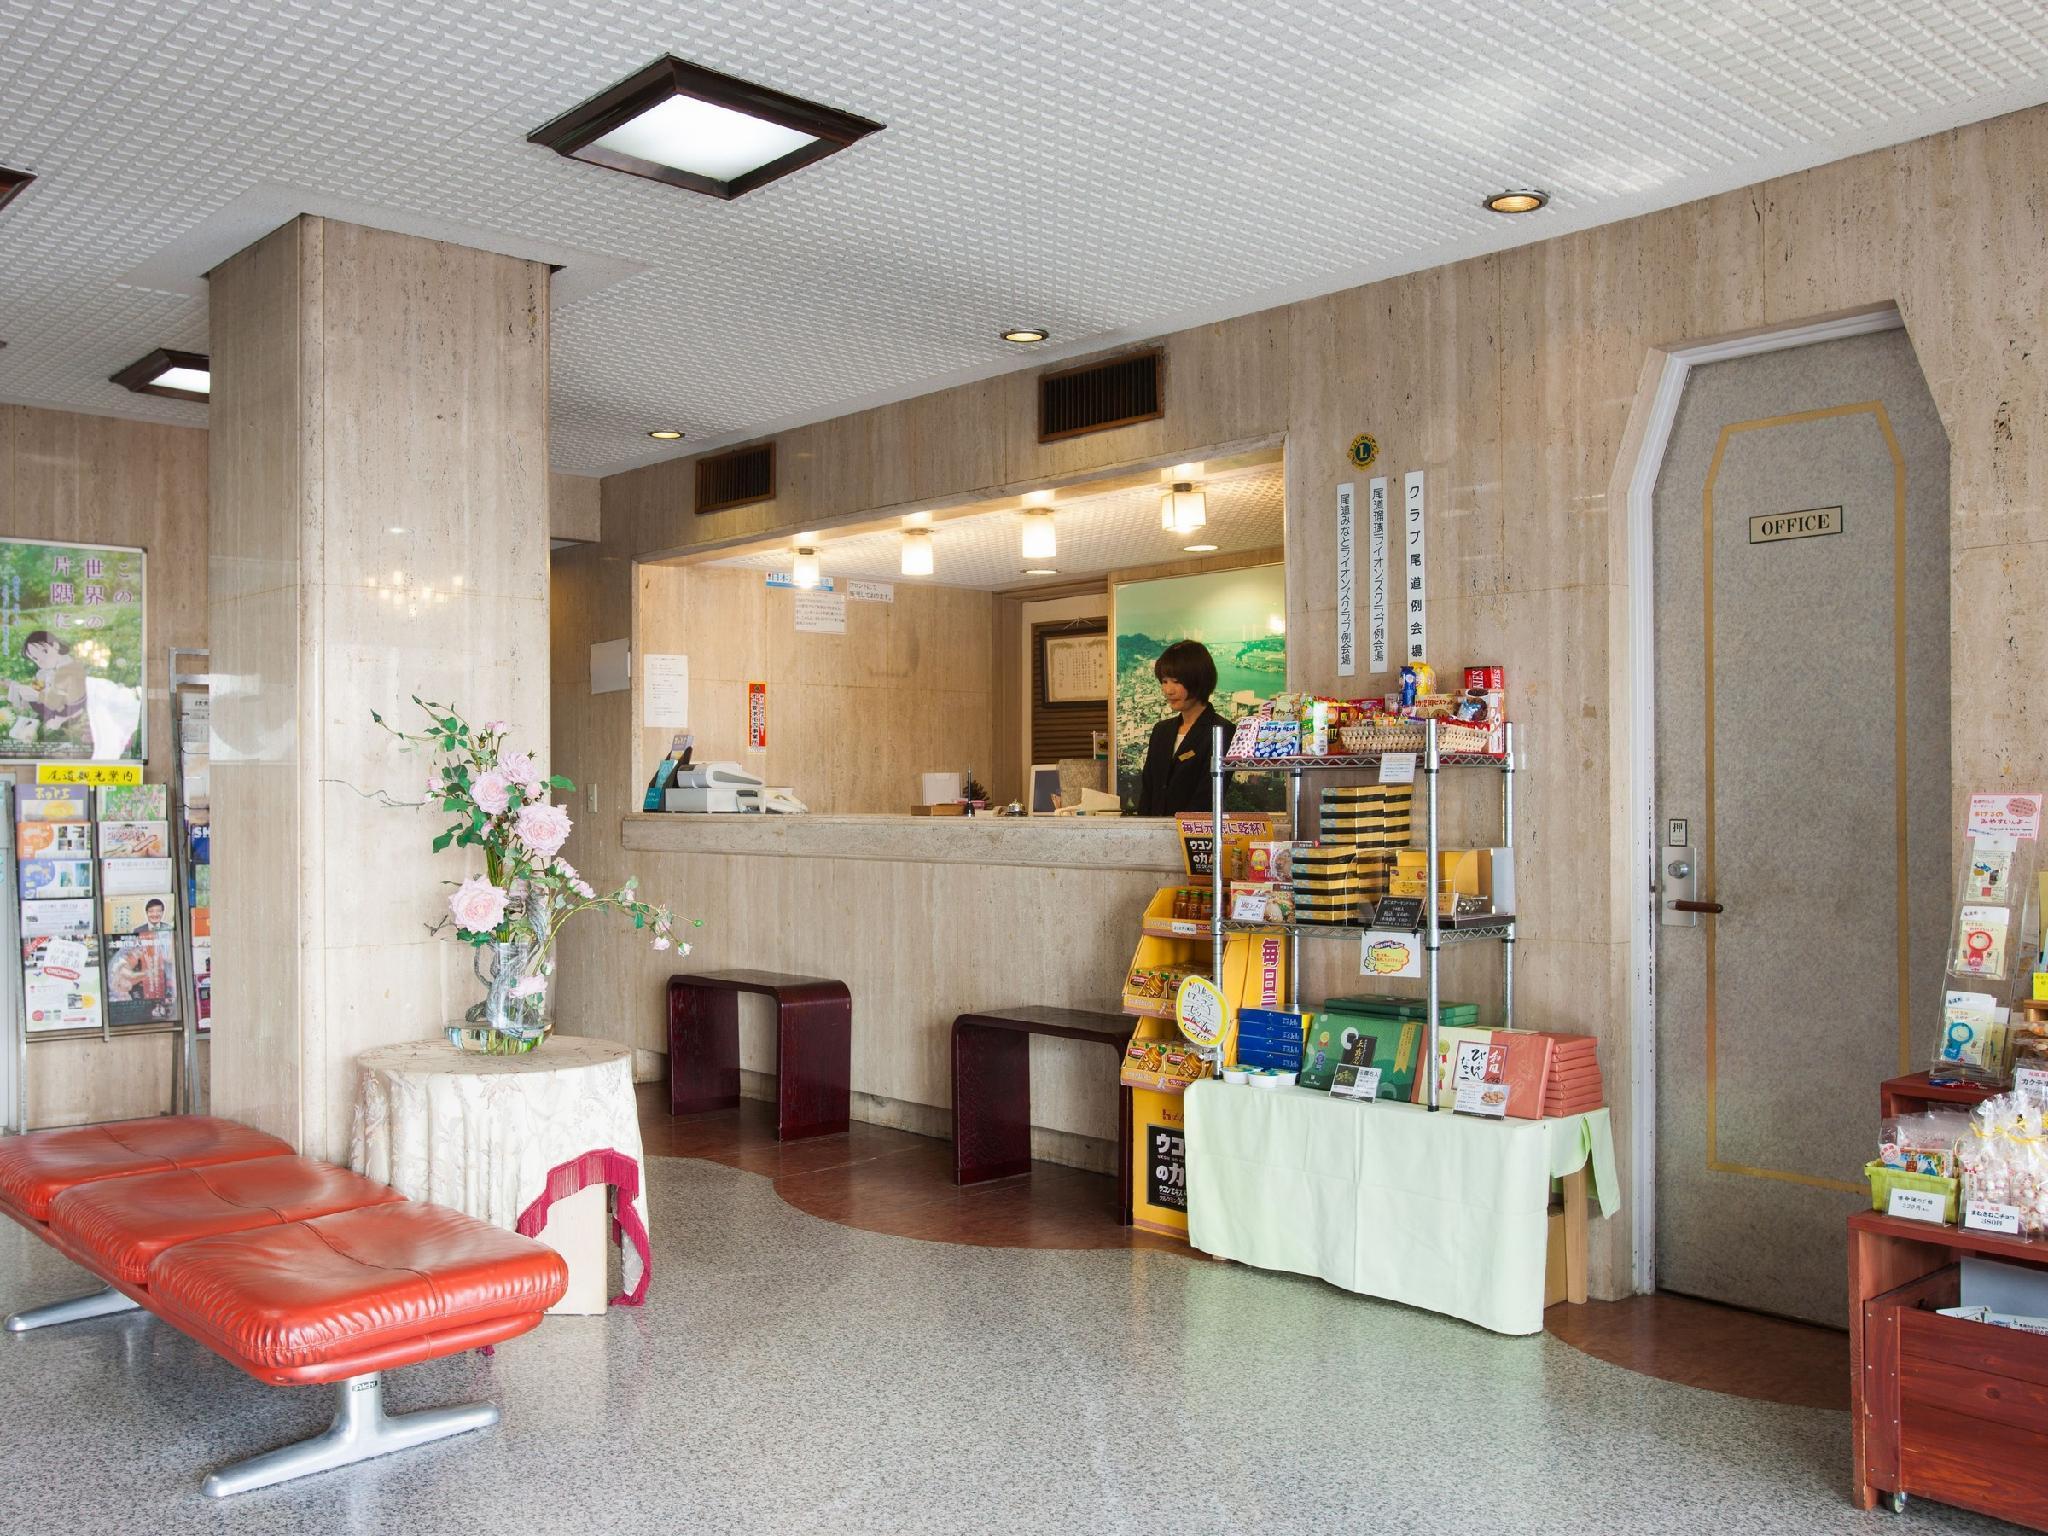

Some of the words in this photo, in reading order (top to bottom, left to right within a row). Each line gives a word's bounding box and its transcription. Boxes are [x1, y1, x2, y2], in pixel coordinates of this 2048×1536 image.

[1761, 514, 1829, 536] OFFICE
[50, 556, 74, 629] 片隅に
[85, 558, 105, 629] 世界の
[1189, 840, 1213, 850] ウコン
[1156, 1162, 1184, 1187] の力
